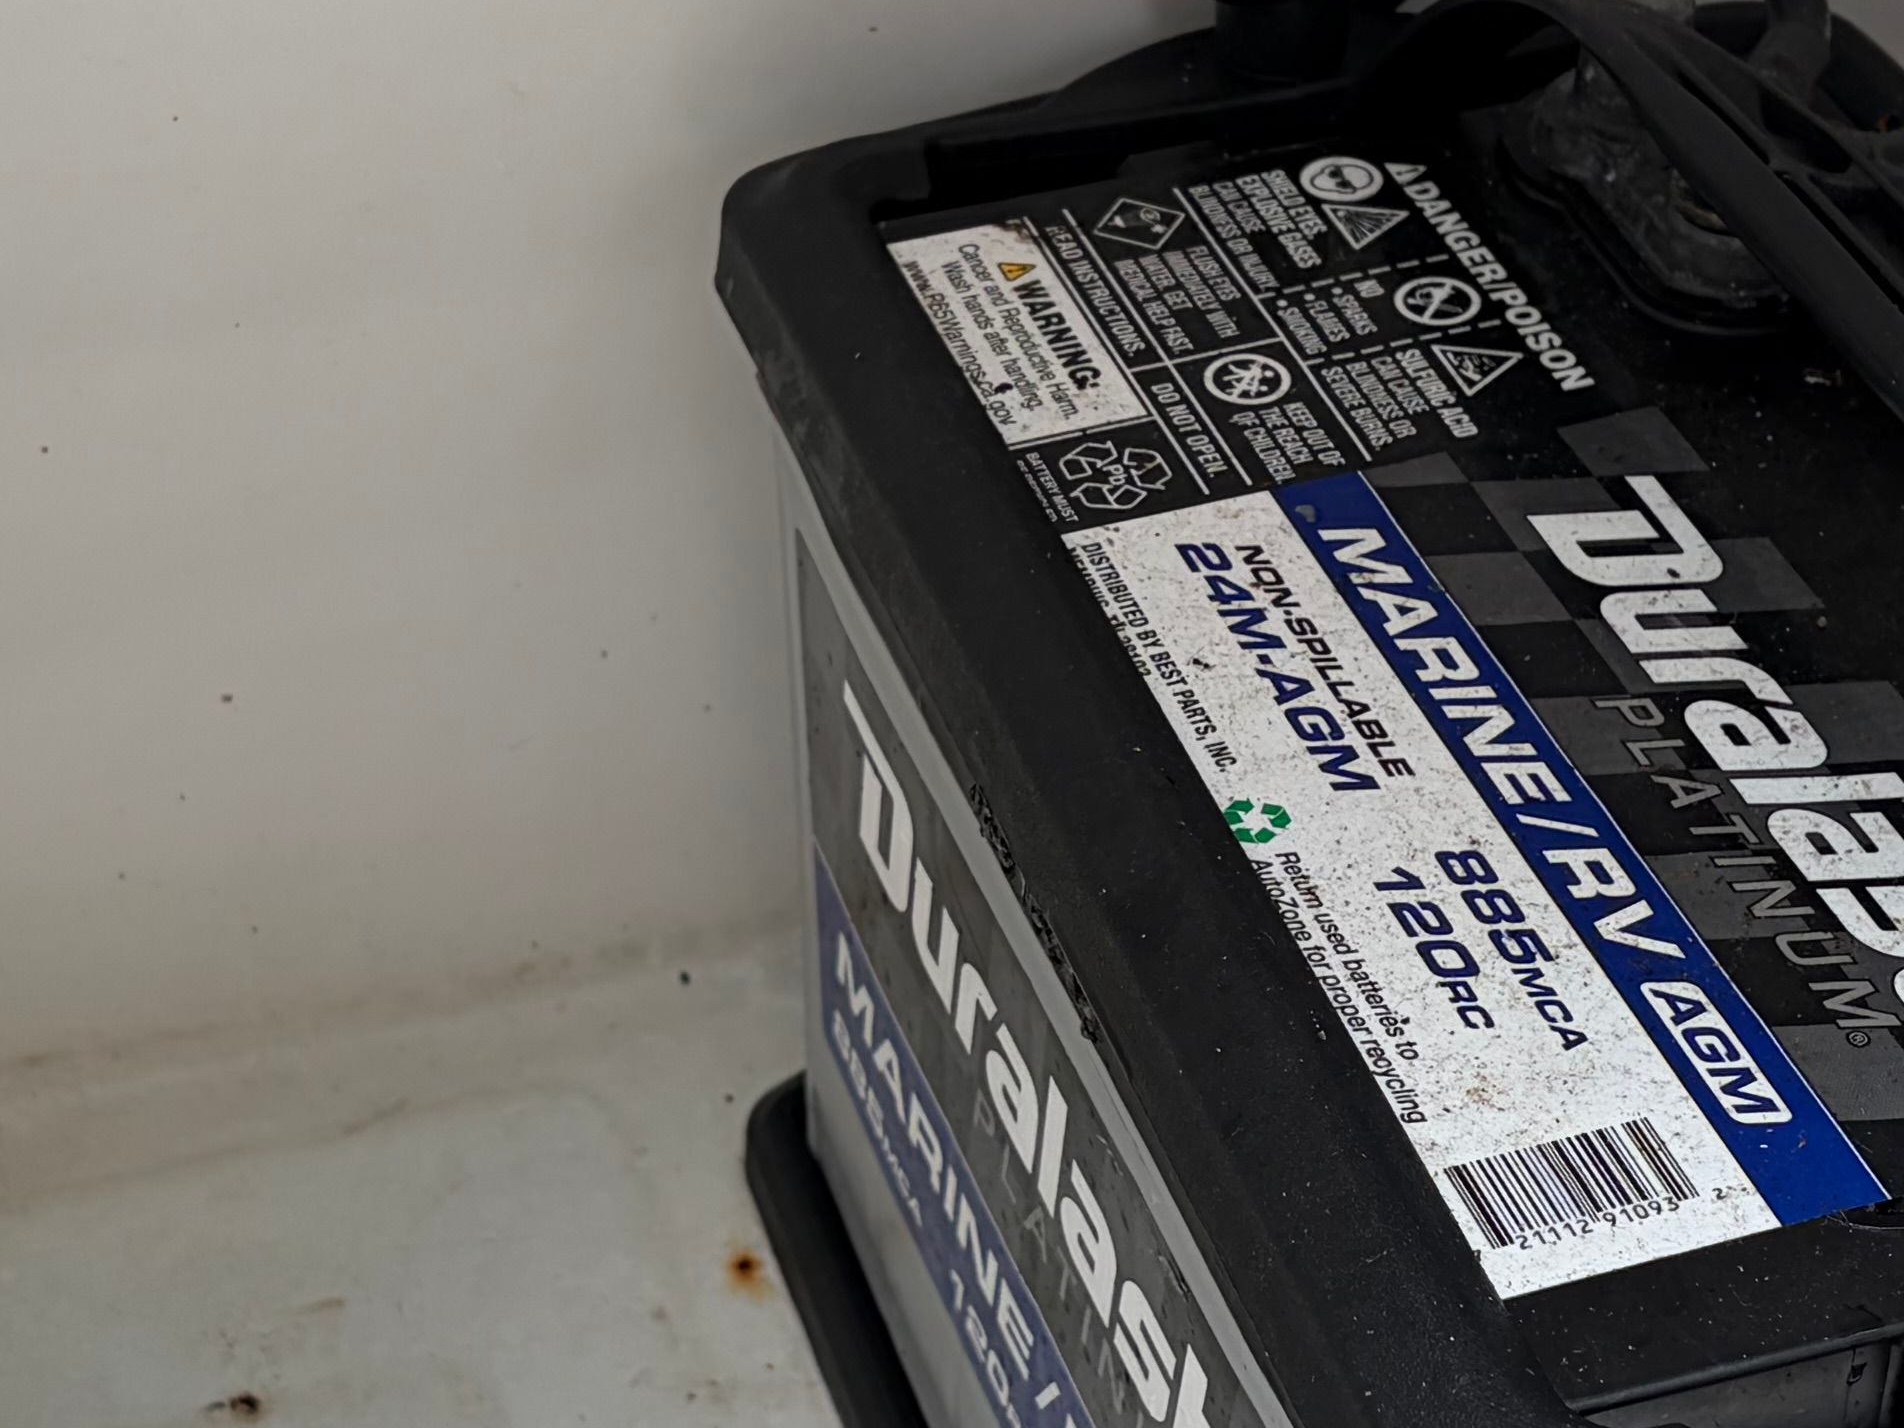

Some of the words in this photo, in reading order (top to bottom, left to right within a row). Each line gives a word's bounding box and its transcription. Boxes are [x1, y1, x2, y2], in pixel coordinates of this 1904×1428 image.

[1188, 185, 1242, 239] BLINDNESS
[1226, 237, 1253, 255] OR
[1213, 180, 1243, 203] CAN
[1227, 200, 1266, 234] CAUSE
[1235, 173, 1296, 234] EXPLOSIVE
[1278, 230, 1322, 269] GASES
[1261, 169, 1306, 207] SHIELD
[1047, 226, 1084, 260] READ
[1068, 259, 1146, 357] INSTRUCTIONS.
[1113, 258, 1158, 302] MEDICAL
[1142, 302, 1177, 327] HELP
[1160, 326, 1195, 355] FAST.
[1161, 250, 1221, 311] IMMEDIATELY
[1205, 309, 1241, 339] WITH
[1162, 289, 1193, 311] GET
[1186, 245, 1225, 277] FLUSH
[1208, 275, 1241, 302] EYES
[1353, 279, 1385, 299] NO
[1404, 181, 1595, 391] DANGER/POISON
[942, 261, 971, 295] Wash
[962, 290, 995, 331] hands
[984, 329, 1012, 358] after
[1000, 357, 1043, 412] handling.
[958, 243, 993, 285] Cancer
[984, 284, 1008, 307] and
[999, 306, 1057, 382] Reproductive
[1046, 380, 1080, 421] Harm.
[1277, 307, 1328, 355] SMOKING
[1304, 299, 1351, 343] FLAMES
[1332, 293, 1379, 337] SPARKS
[1283, 401, 1317, 428] KEEP
[1321, 367, 1367, 410] SEVERE
[1349, 407, 1394, 451] BURNS.
[1346, 362, 1405, 422] BLINDNESS
[1389, 418, 1418, 440] OR
[1371, 355, 1399, 378] CAN
[1388, 375, 1431, 415] CAUSE
[1396, 348, 1457, 407] SULFURIC
[1437, 405, 1480, 439] ACID
[1150, 382, 1175, 405] DO
[1165, 404, 1202, 434] NOT
[1185, 432, 1229, 478] OPEN.
[1229, 409, 1257, 429] OF
[1243, 424, 1296, 484] CHILDREN.
[1259, 406, 1286, 430] THE
[1273, 425, 1314, 465] REACH
[1300, 427, 1335, 453] OUT
[1316, 449, 1346, 468] OF
[1025, 452, 1062, 494] BATTERY
[1052, 494, 1079, 522] MUST
[1100, 463, 1127, 488] Pb
[1081, 542, 1149, 628] DISTRIBUTED
[1136, 629, 1164, 651] BY
[1149, 651, 1188, 687] BEST
[1174, 542, 1381, 792] 24M-AGM
[1235, 544, 1416, 777] NON-SPILLABLE
[1173, 689, 1217, 741] PARTS,
[1204, 741, 1238, 772] INC.
[1316, 527, 1687, 962] MARINE/RV
[1651, 987, 1782, 1117] AGM
[1274, 851, 1323, 909] Return
[1314, 912, 1358, 956] used
[1342, 958, 1405, 1037] batteries
[1395, 1040, 1420, 1061] to
[1250, 859, 1312, 942] AutoZone
[1302, 945, 1333, 978] for
[1320, 974, 1374, 1039] proper
[1360, 1038, 1429, 1125] recycling
[1515, 1218, 1595, 1250] 21112
[1603, 1196, 1681, 1227] 91093
[1712, 1187, 1727, 1202] 2
